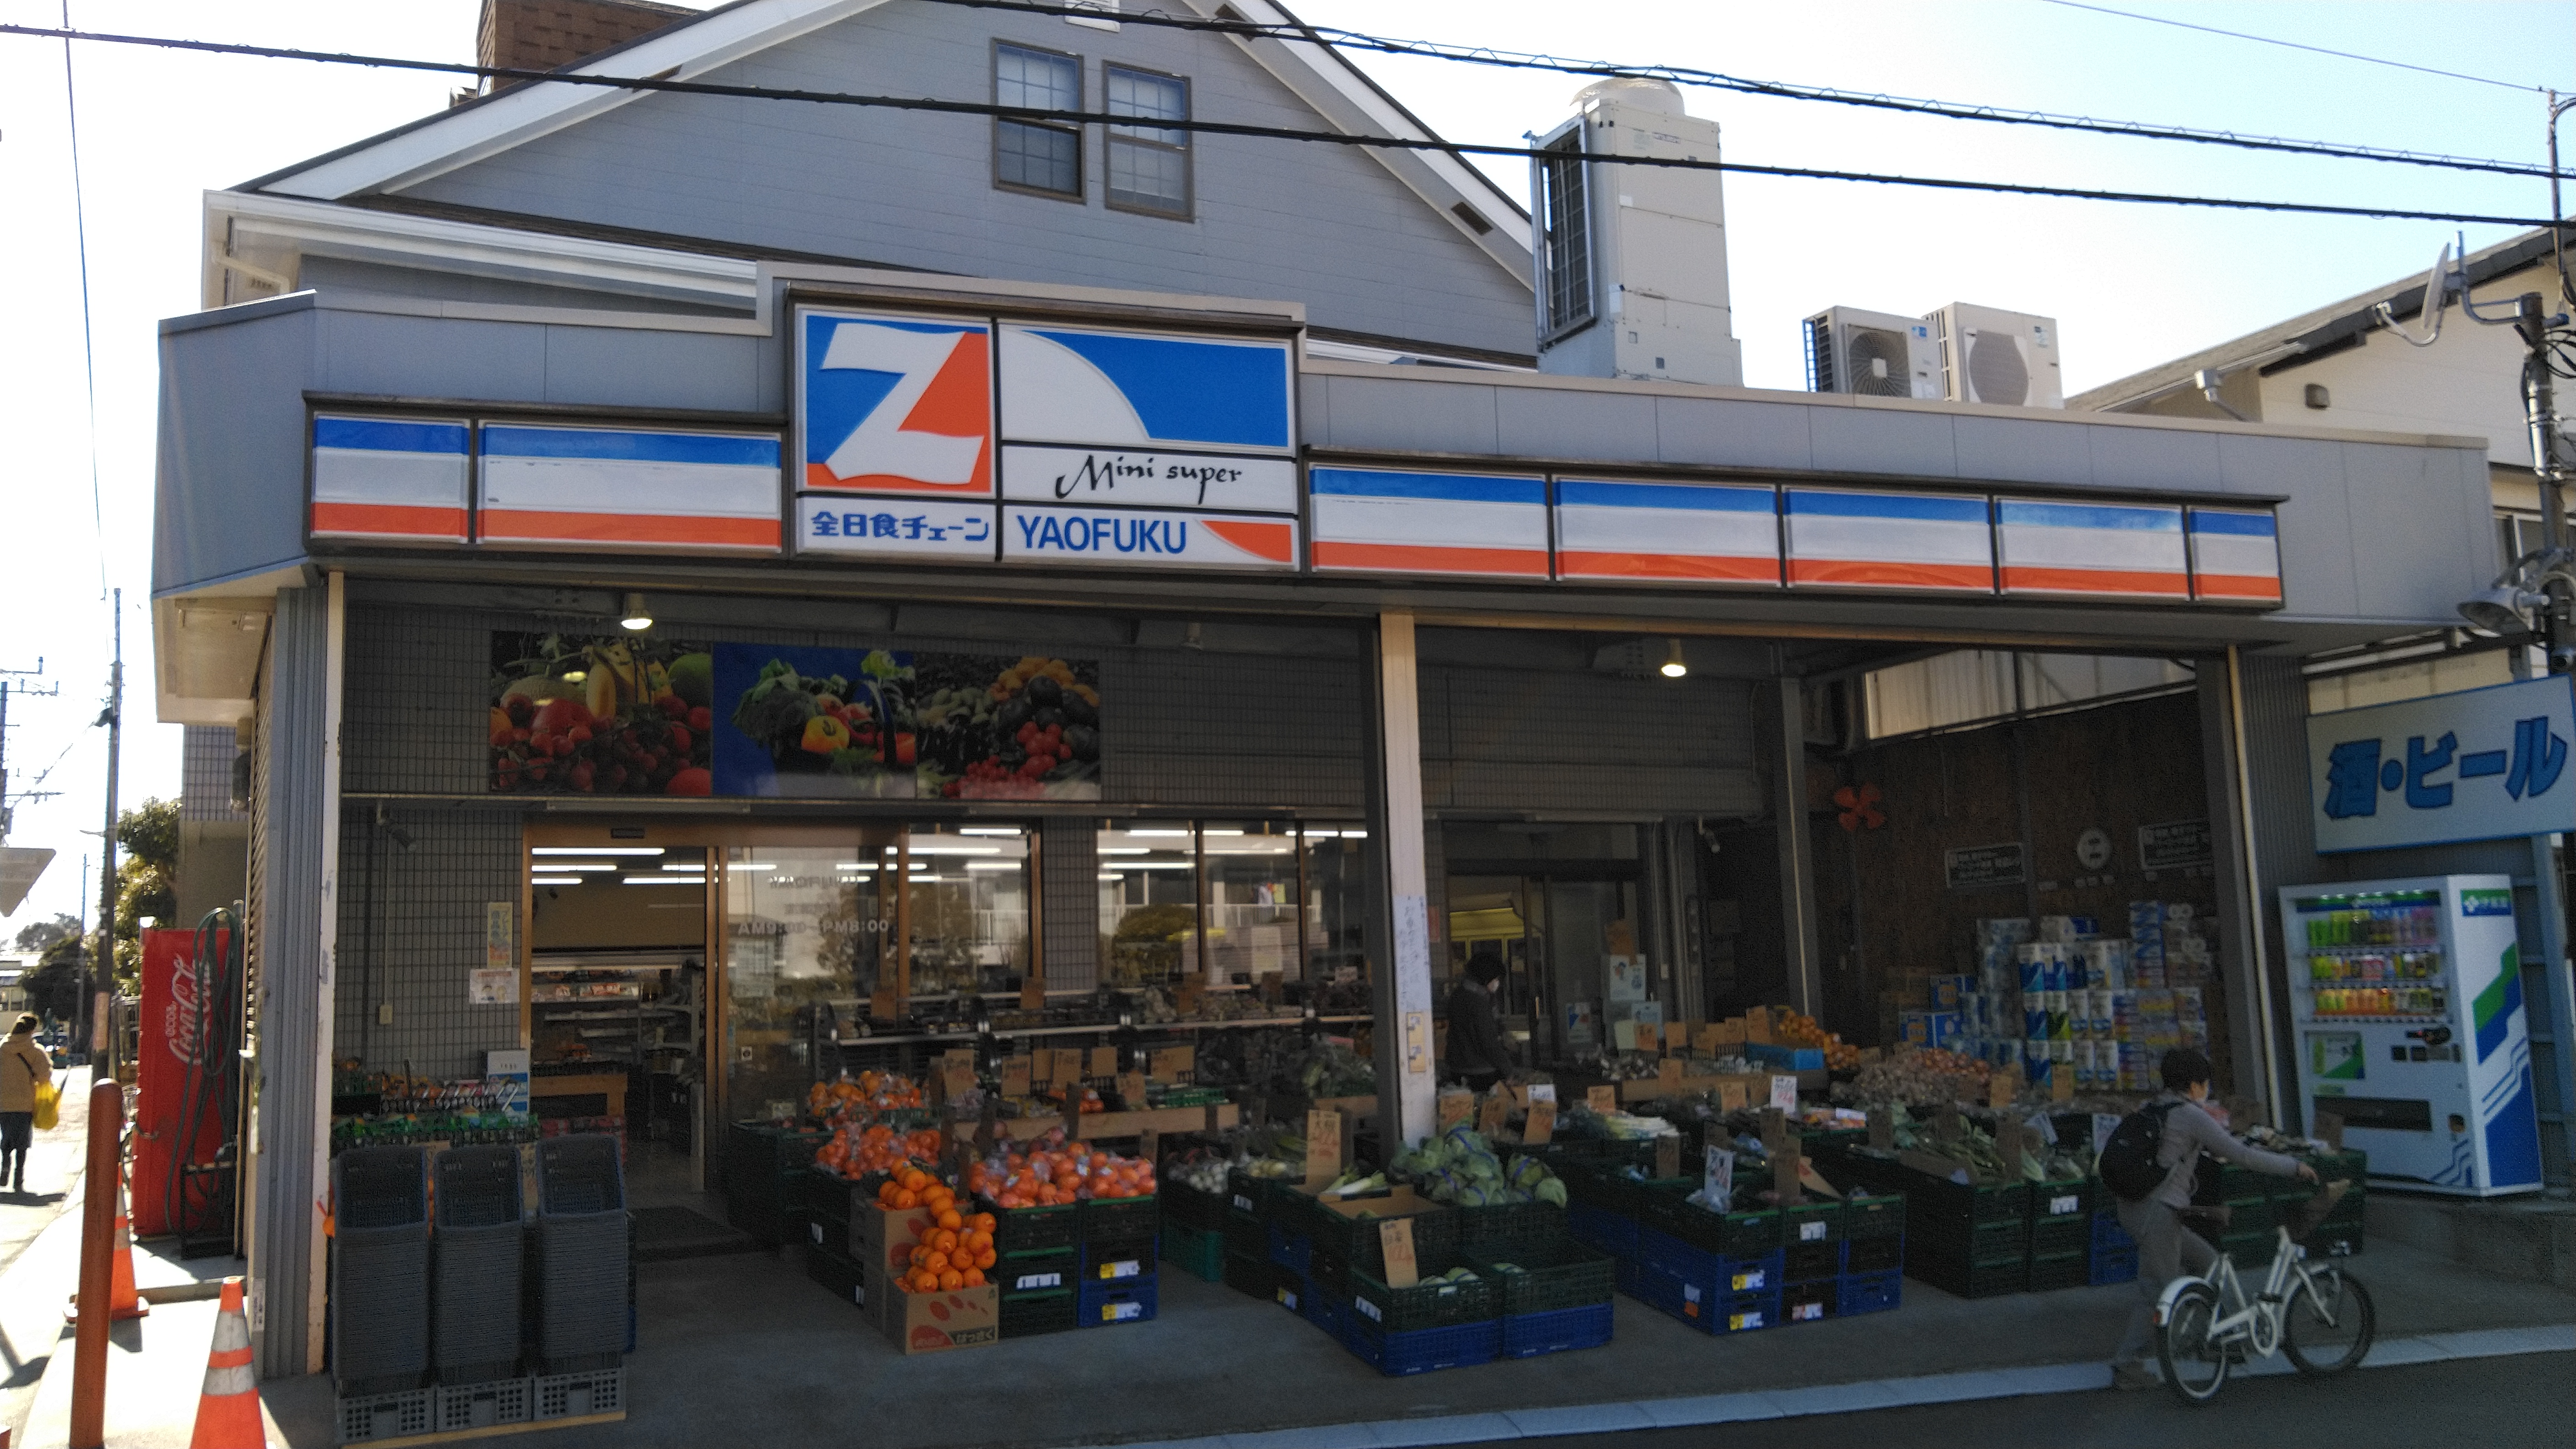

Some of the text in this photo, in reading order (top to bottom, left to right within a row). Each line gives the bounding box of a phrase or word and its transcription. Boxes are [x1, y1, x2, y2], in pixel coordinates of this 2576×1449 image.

[1055, 455, 1242, 505] Mini super
[810, 511, 989, 542] 全日食チェーン
[1016, 515, 1186, 554] YAOFUKU
